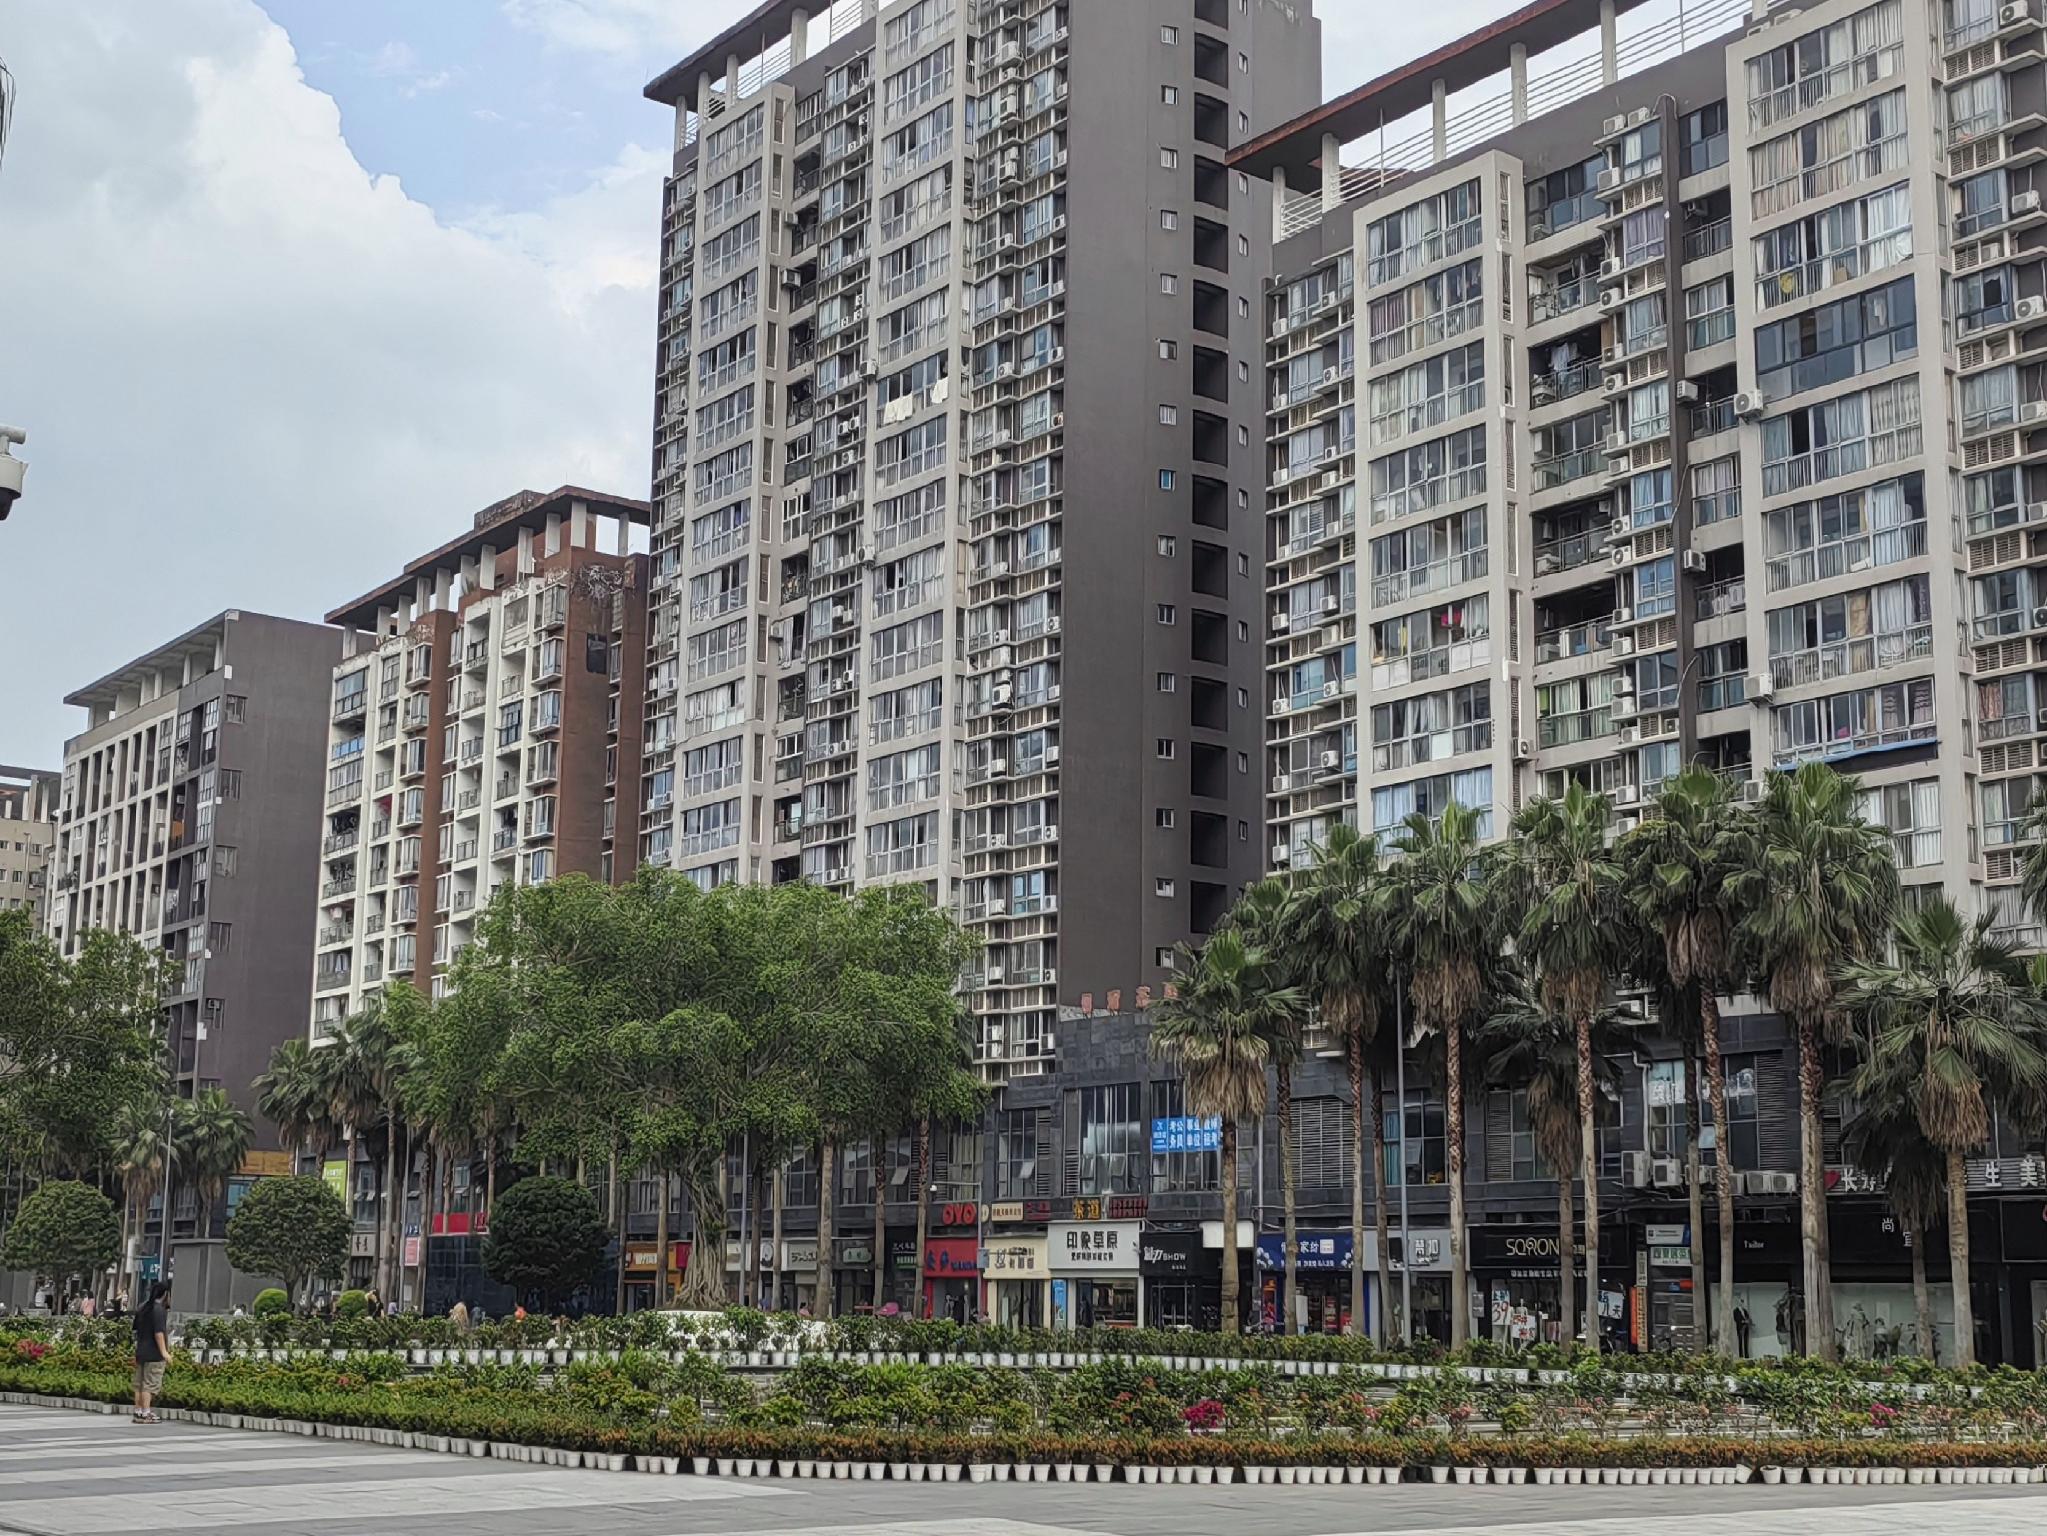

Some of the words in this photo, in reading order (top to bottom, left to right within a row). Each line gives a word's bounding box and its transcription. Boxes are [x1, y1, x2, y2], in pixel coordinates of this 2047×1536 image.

[943, 1202, 976, 1225] OYO
[1067, 1230, 1118, 1250] 印象草原
